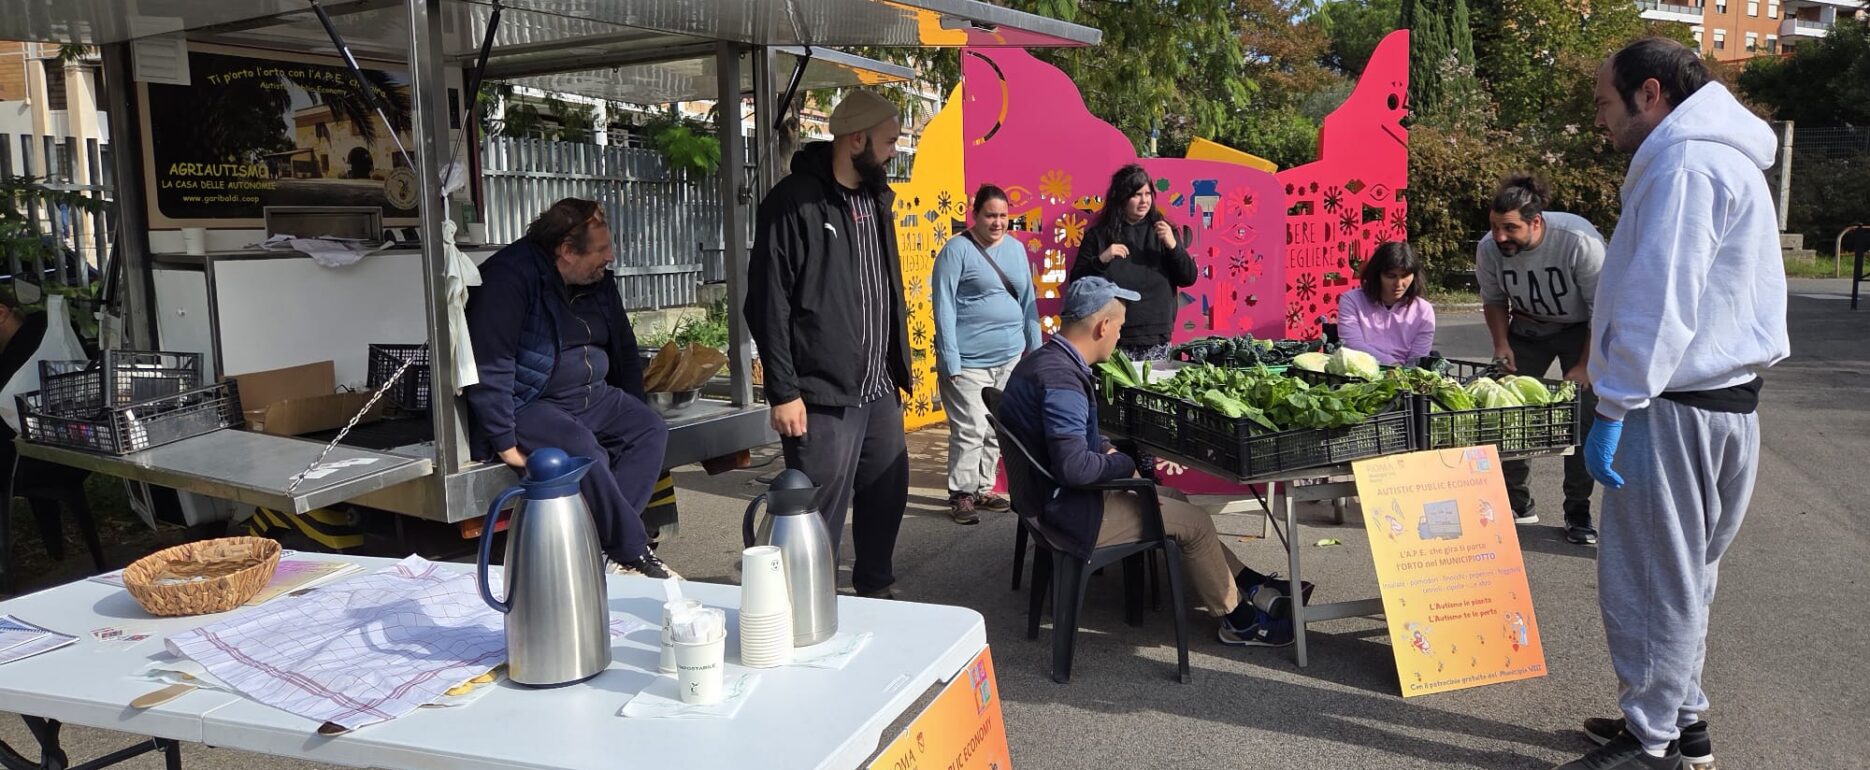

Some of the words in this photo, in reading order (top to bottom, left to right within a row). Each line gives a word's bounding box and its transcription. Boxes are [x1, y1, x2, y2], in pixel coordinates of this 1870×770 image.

[208, 75, 221, 86] Ti
[224, 70, 254, 85] p'orto
[257, 66, 285, 78] l'orto
[288, 70, 304, 79] con
[169, 162, 267, 178] AGRIAUTISMO
[162, 180, 173, 189] LA
[175, 180, 198, 189] CASA
[200, 181, 225, 190] DELLE
[228, 181, 277, 190] AUTONOMIE
[183, 195, 260, 204] www.garibaldi.coop
[1286, 221, 1316, 245] BERE
[1324, 221, 1336, 243] DI
[1286, 246, 1335, 269] EGLIERE
[1502, 266, 1568, 316] GAP
[1377, 485, 1414, 496] AUTISTIC
[1416, 482, 1447, 491] PUBLIC
[1447, 478, 1489, 488] ECONOMY
[1430, 547, 1443, 556] che
[1444, 545, 1459, 556] gira
[1467, 543, 1487, 553] porta
[1396, 561, 1424, 571] l'ORTO
[1425, 559, 1438, 568] nel
[1440, 552, 1496, 566] MUNICIPIOTTO
[1429, 601, 1463, 611] L'Autismo
[1428, 612, 1462, 623] L'Autismo
[962, 716, 992, 763] ECONOMY
[890, 749, 917, 770] OMA
